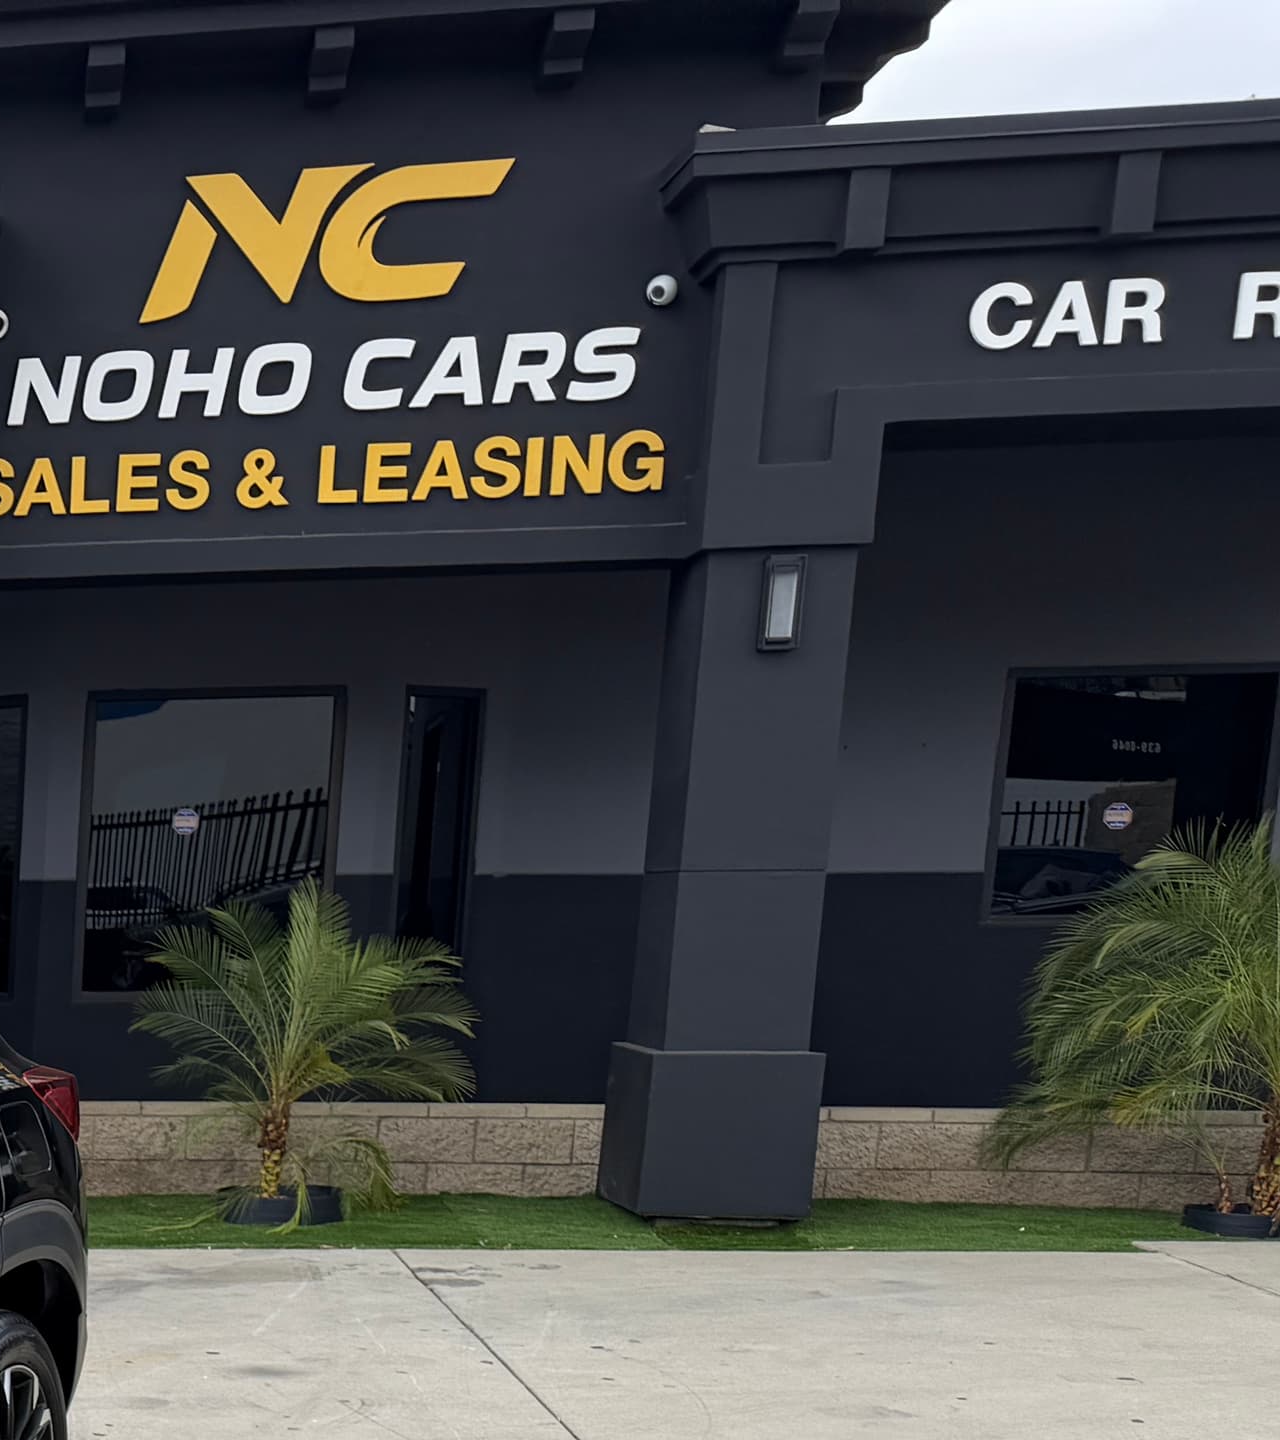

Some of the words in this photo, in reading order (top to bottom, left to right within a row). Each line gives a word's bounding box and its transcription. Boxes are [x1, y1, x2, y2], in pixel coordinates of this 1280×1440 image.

[968, 277, 1166, 350] CAR
[7, 343, 313, 426] NOHO
[343, 327, 642, 411] CARS
[235, 449, 289, 509] &
[318, 430, 666, 504] LEASING
